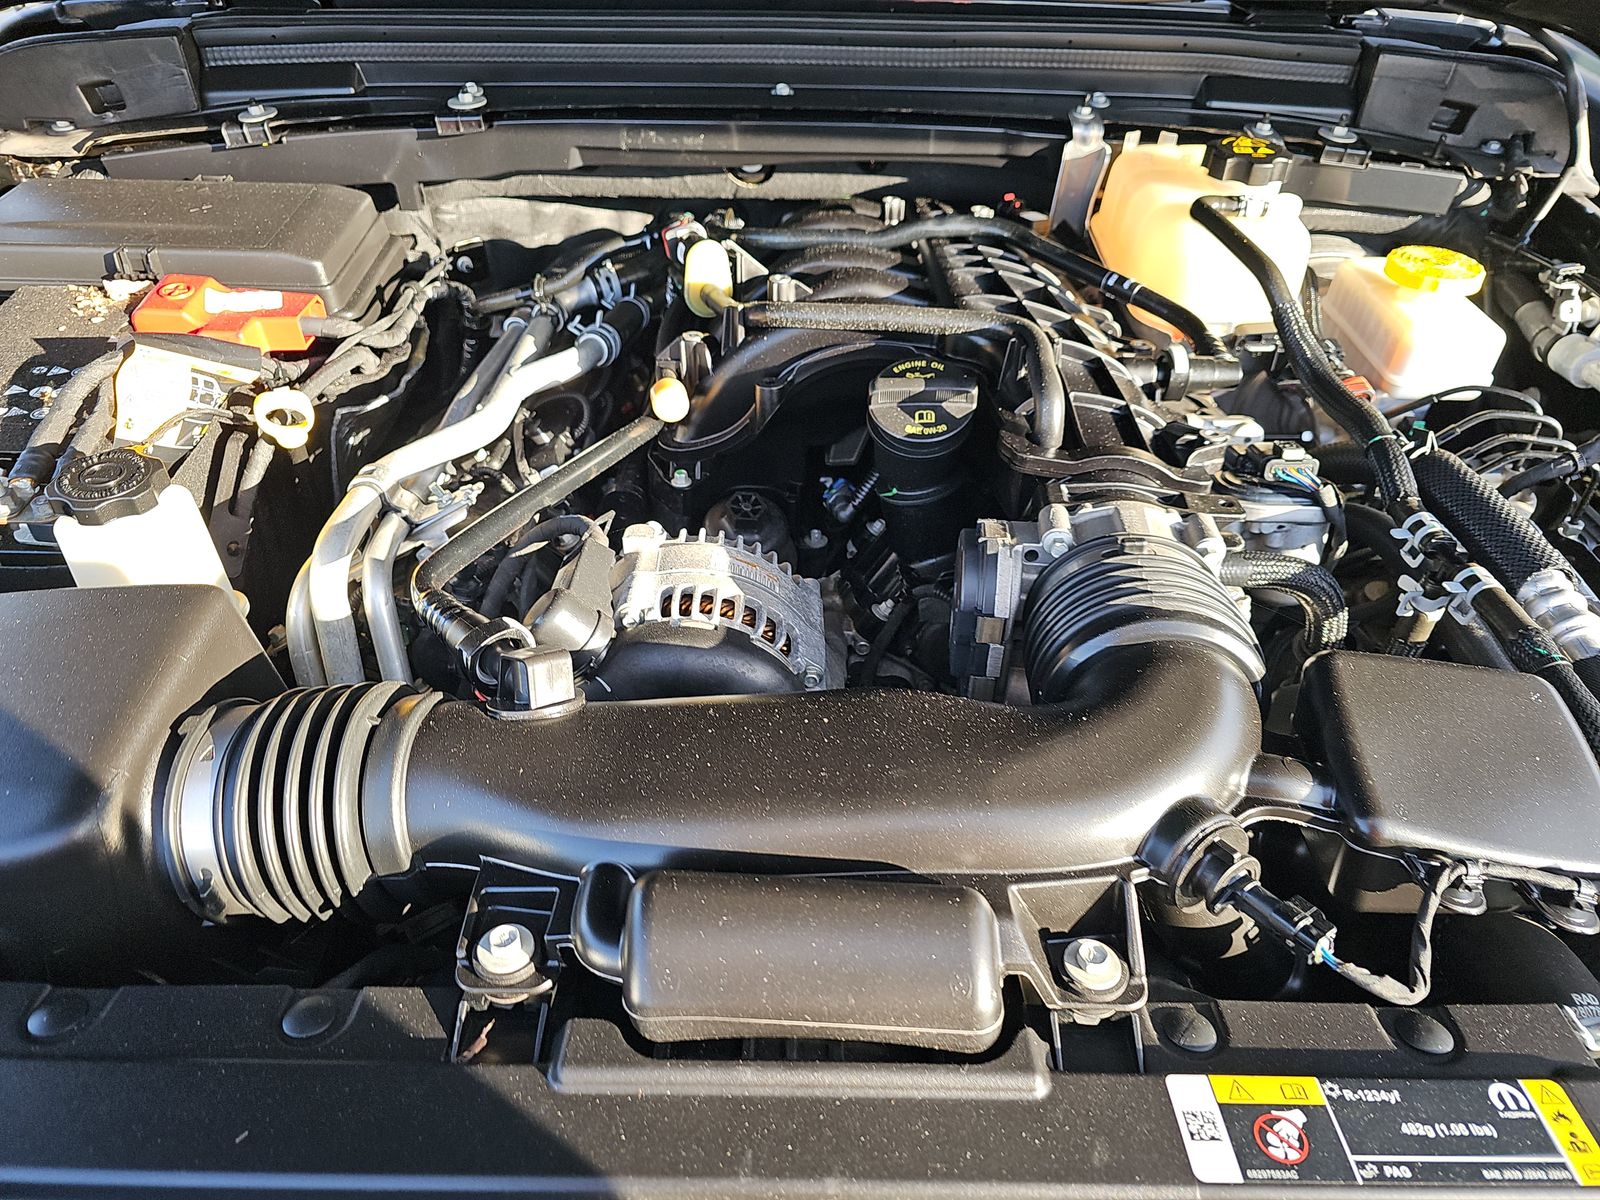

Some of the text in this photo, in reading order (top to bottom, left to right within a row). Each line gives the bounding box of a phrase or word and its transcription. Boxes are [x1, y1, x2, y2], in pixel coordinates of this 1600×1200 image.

[892, 360, 945, 374] ENGINE OIL
[923, 424, 948, 435] 0W-20
[1570, 992, 1600, 1006] RAD
